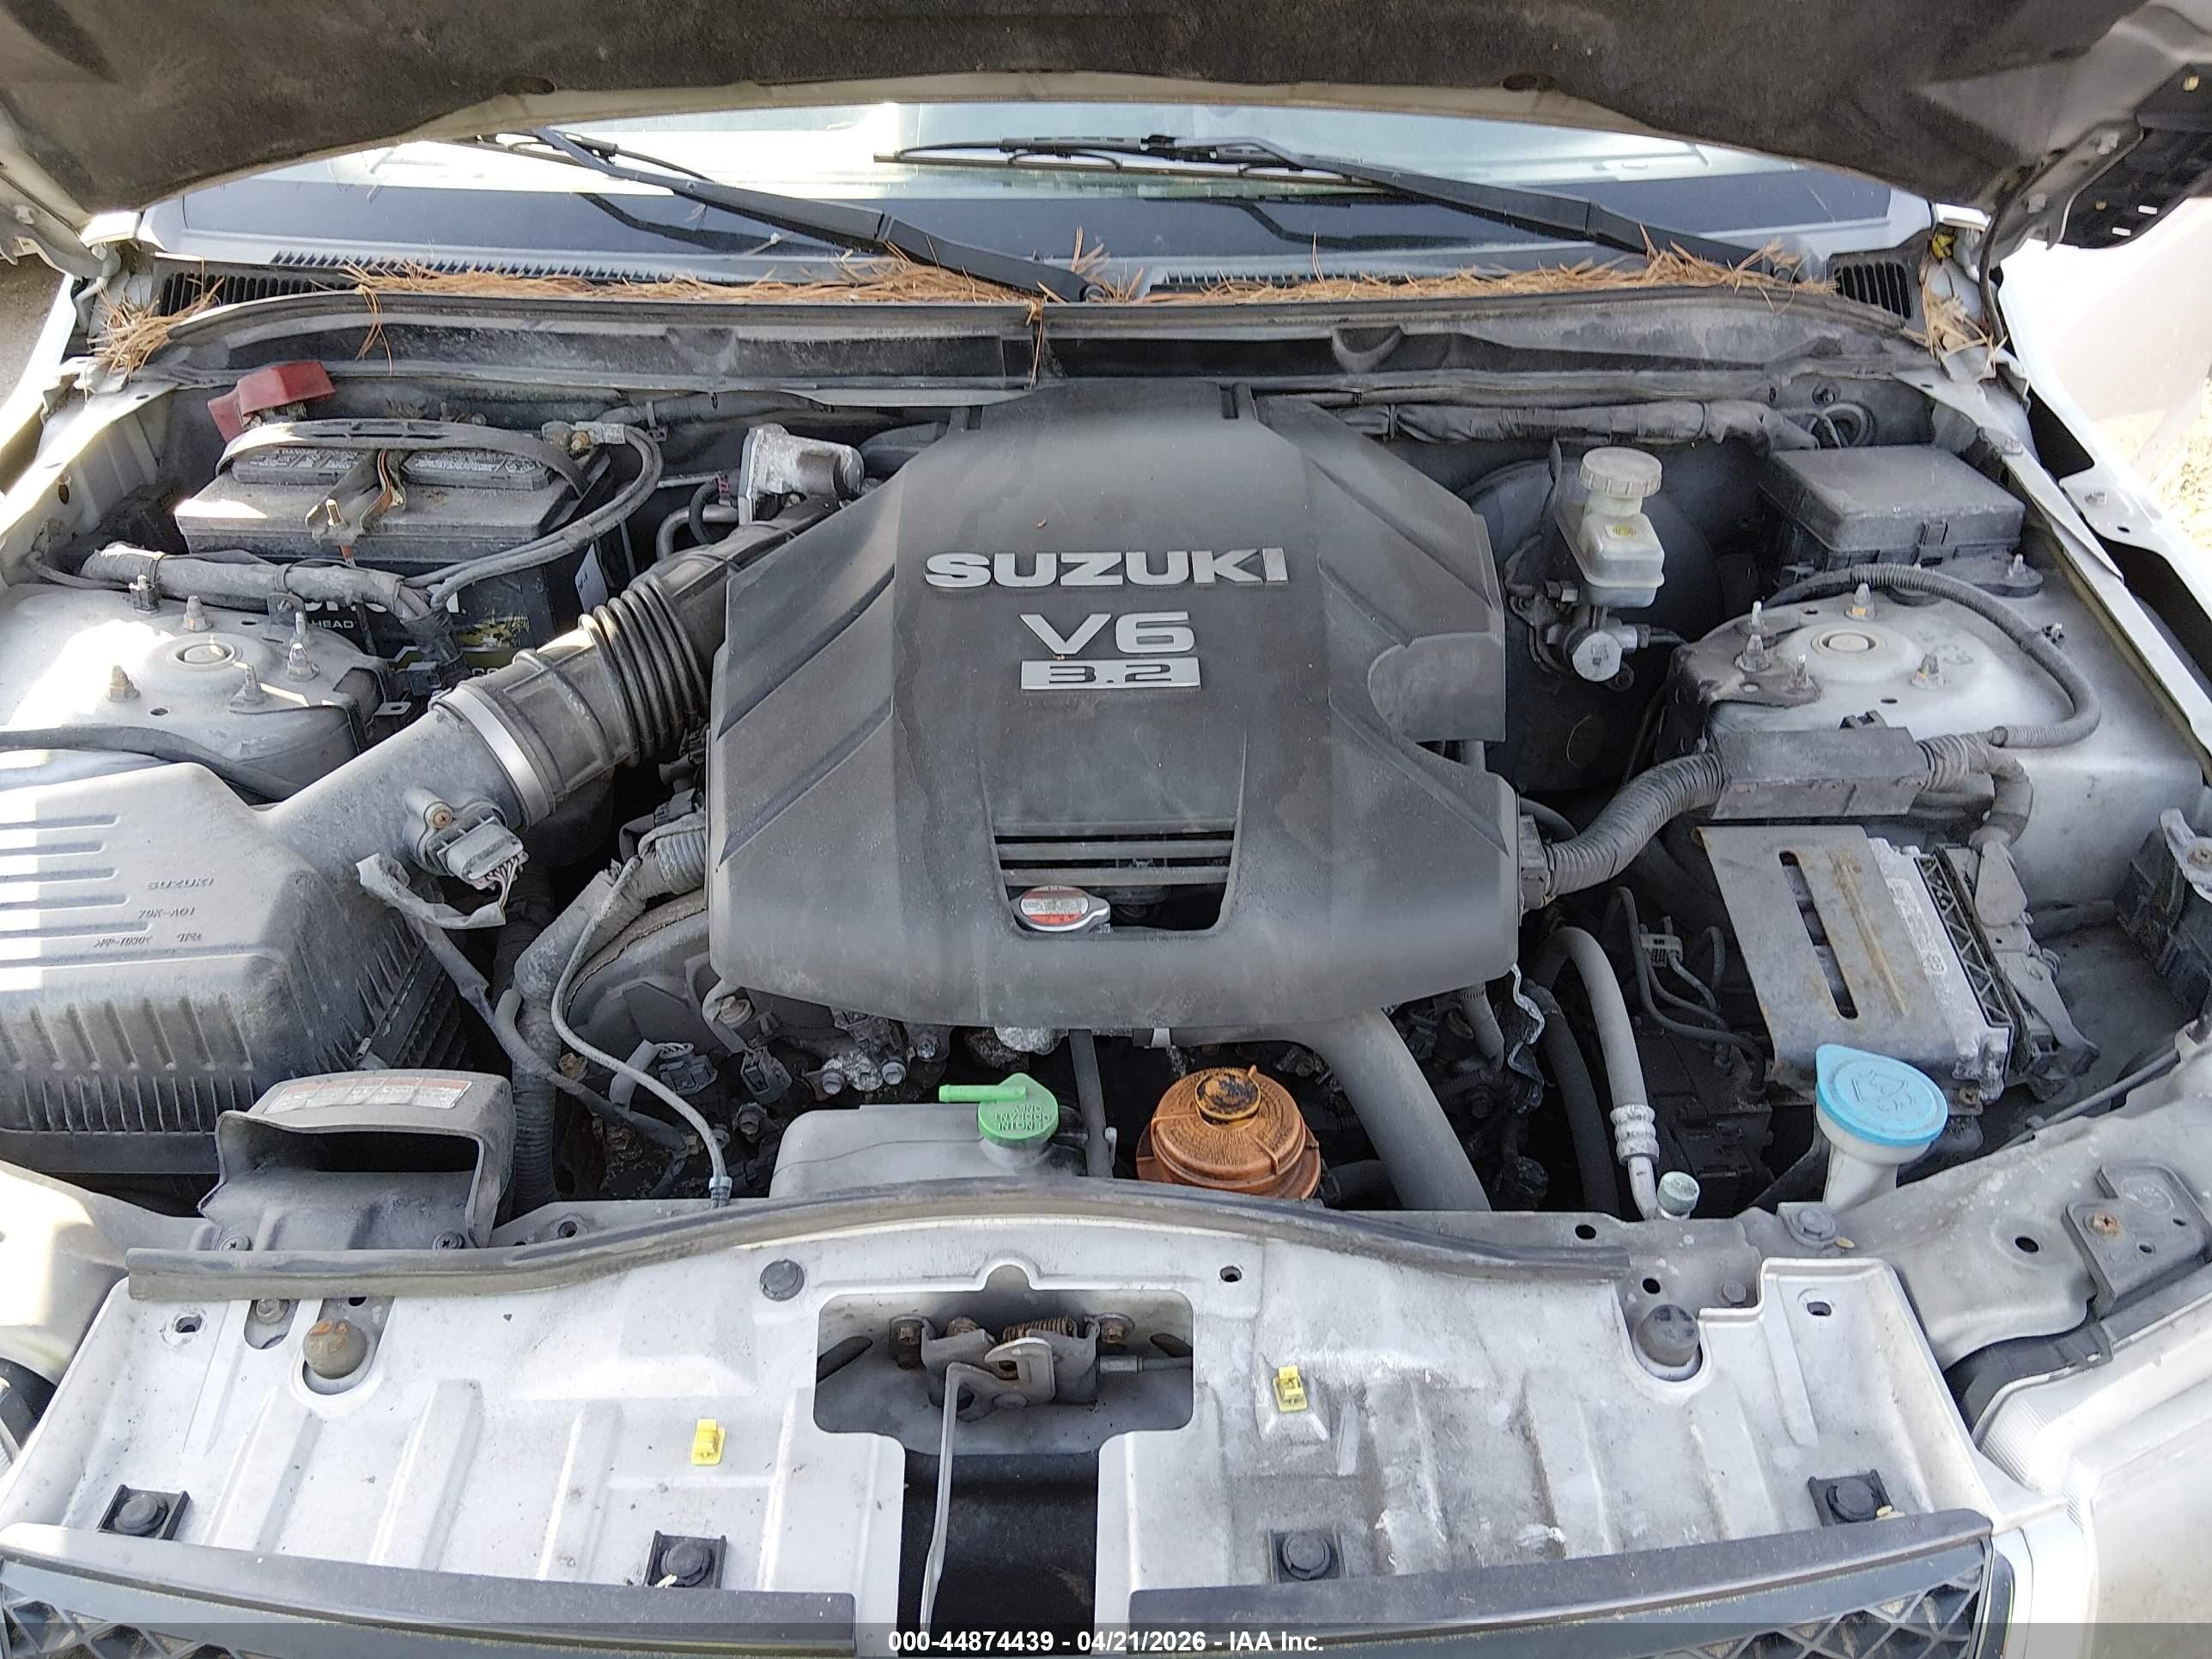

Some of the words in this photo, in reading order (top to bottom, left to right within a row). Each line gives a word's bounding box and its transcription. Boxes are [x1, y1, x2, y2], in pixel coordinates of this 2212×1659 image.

[924, 547, 1289, 588] SUZUKI
[1019, 611, 1195, 655] V6
[1048, 663, 1172, 684] 3.2
[146, 878, 214, 890] SUZUKI
